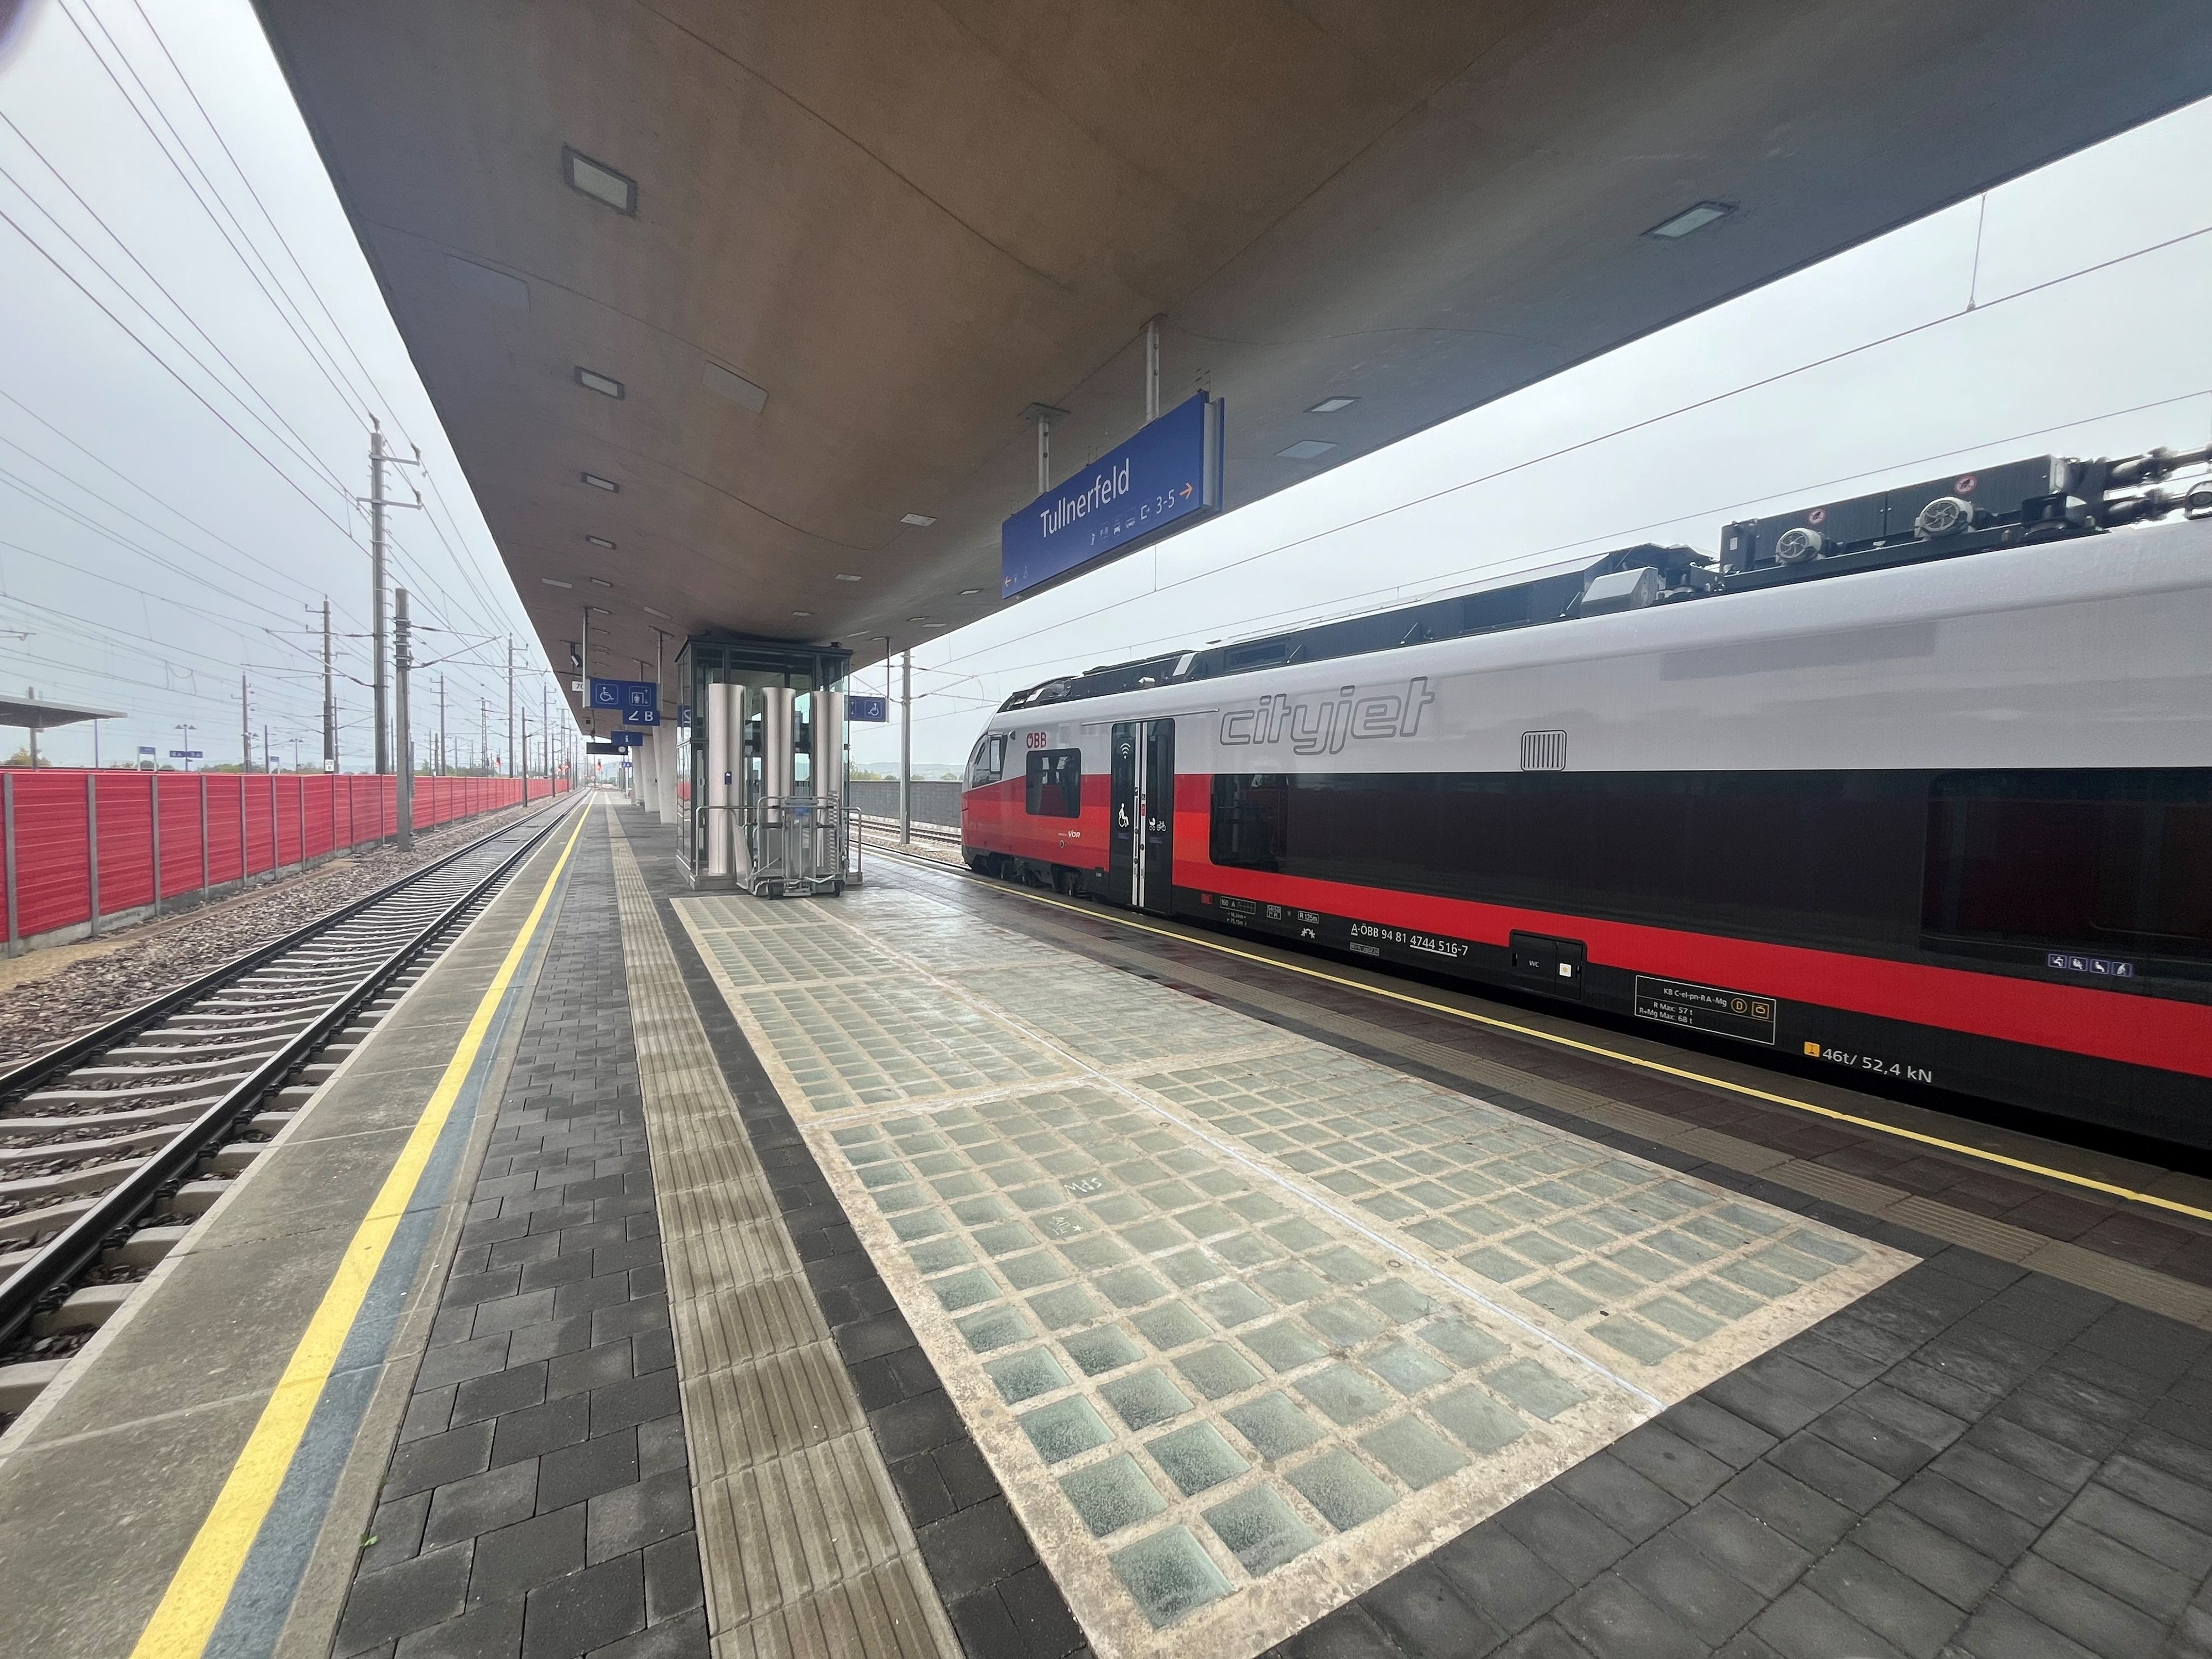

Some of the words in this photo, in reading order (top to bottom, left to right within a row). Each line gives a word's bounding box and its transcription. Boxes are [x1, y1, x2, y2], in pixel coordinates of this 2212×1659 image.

[1040, 457, 1130, 538] Tullnerfeld
[1156, 489, 1175, 514] 3-5
[645, 711, 654, 721] B
[1220, 676, 1436, 756] cityjet
[1068, 830, 1081, 838] VOR
[1351, 923, 1379, 937] A-ÖBB
[1381, 930, 1392, 940] 94
[1395, 932, 1406, 943] 81
[1410, 935, 1435, 949] 4744
[1438, 941, 1468, 956] 516-7
[1529, 959, 1540, 968] WC
[1639, 1007, 1658, 1018] R+Mg
[1822, 1048, 1858, 1065] 46t/
[1862, 1057, 1901, 1076] 52,4
[1907, 1066, 1932, 1083] kN
